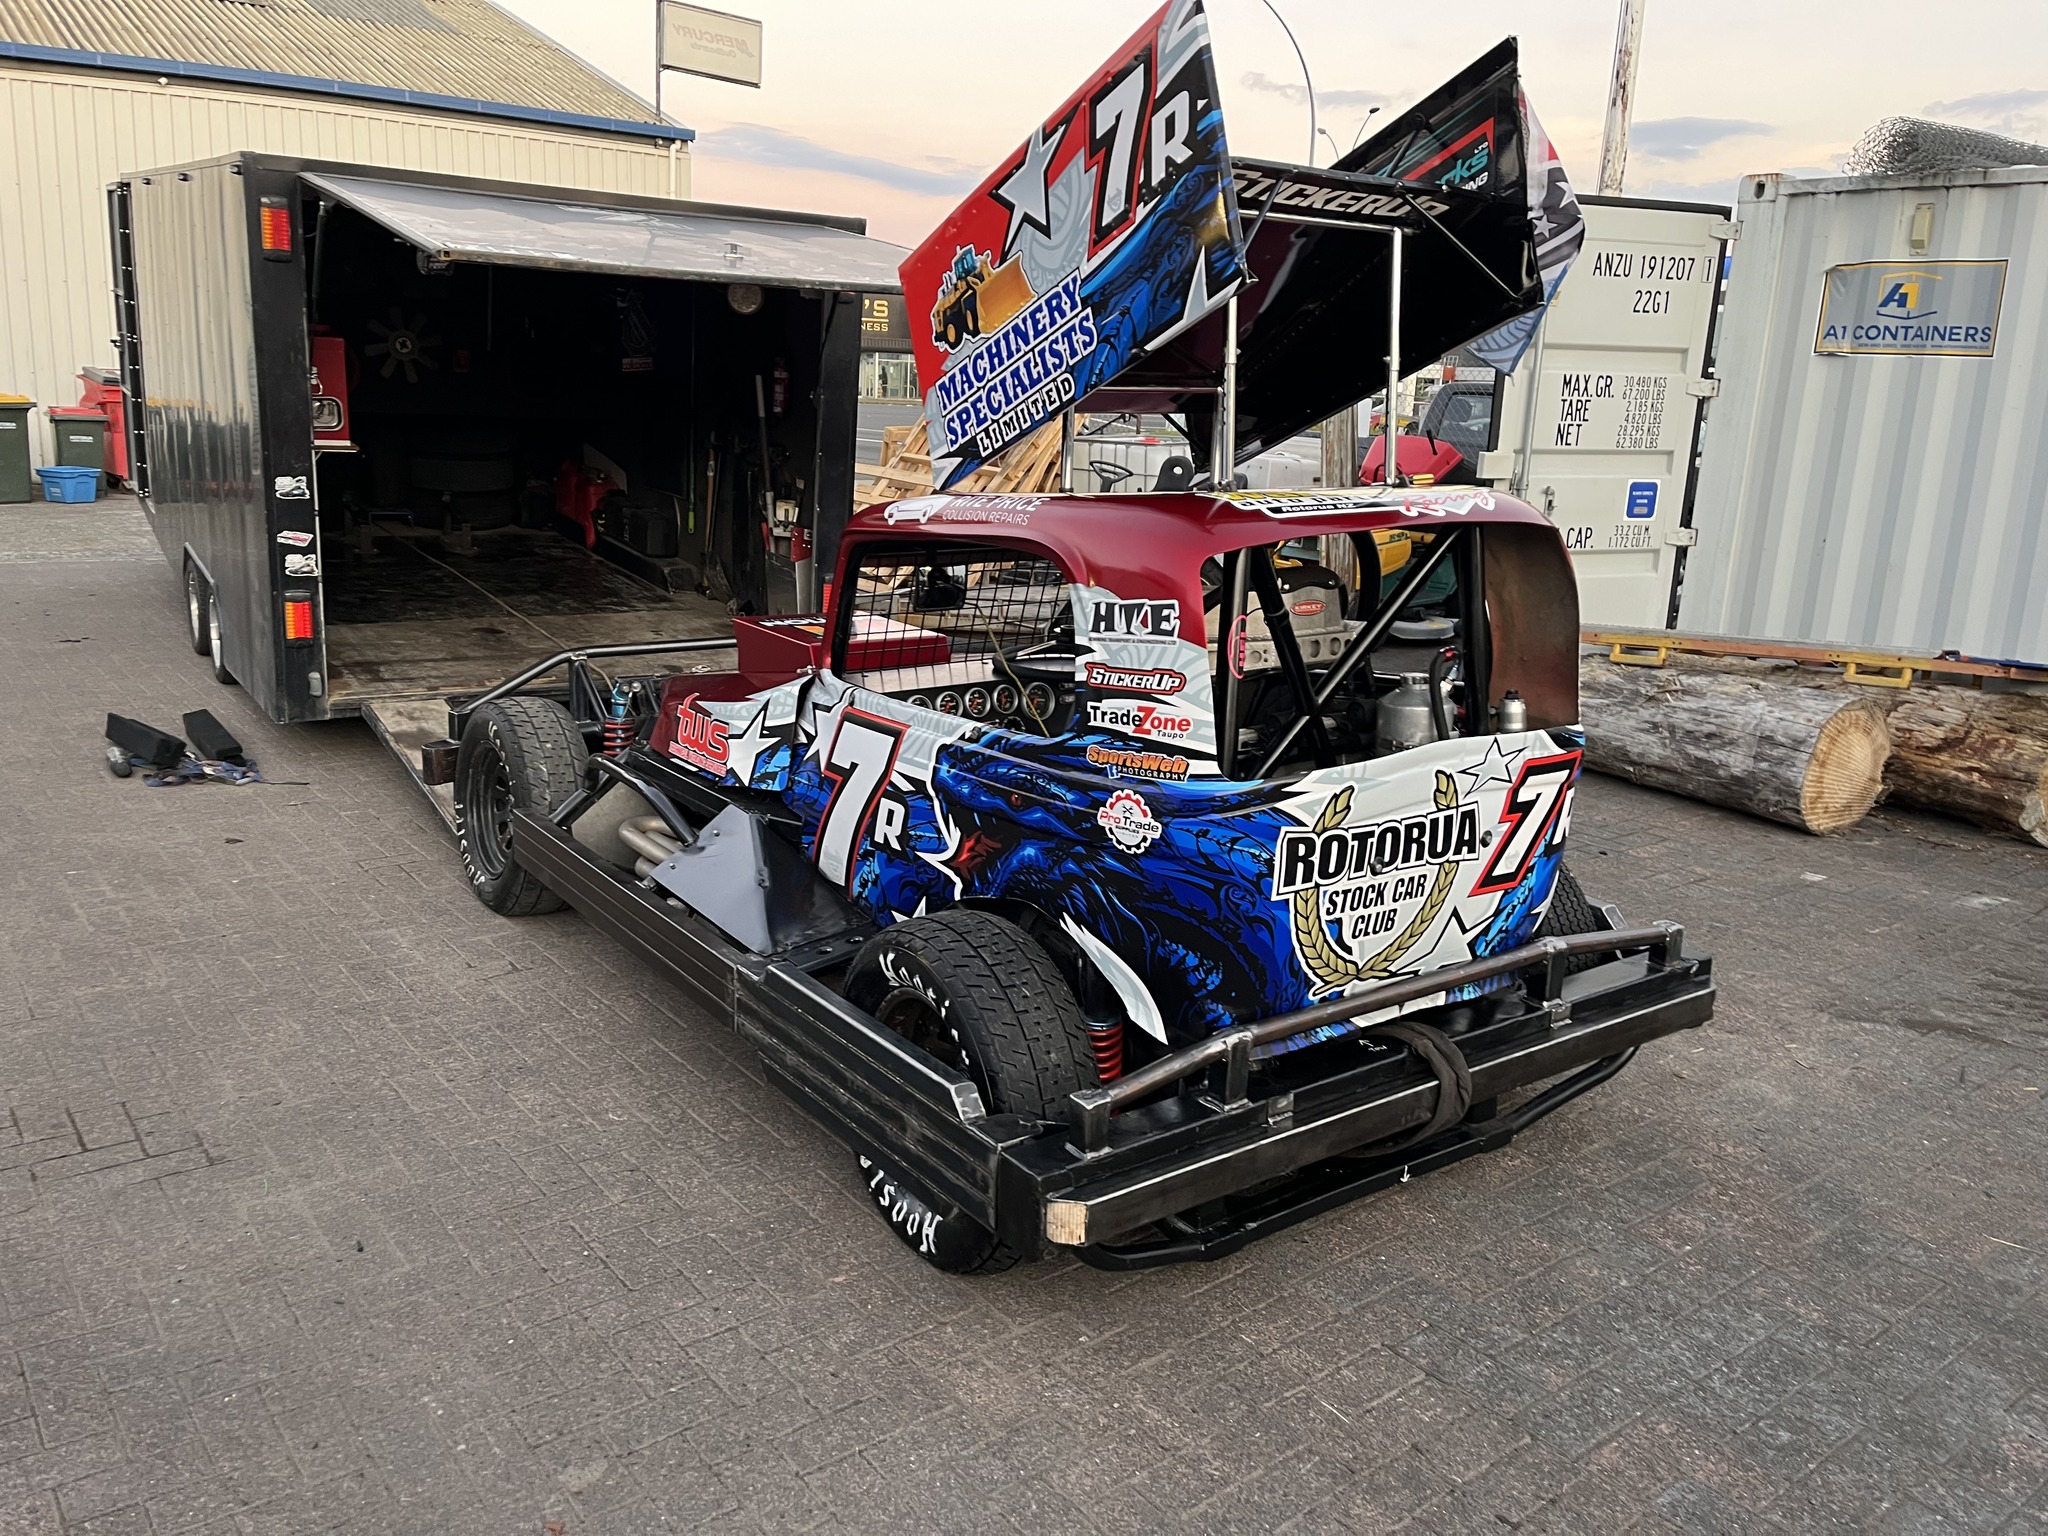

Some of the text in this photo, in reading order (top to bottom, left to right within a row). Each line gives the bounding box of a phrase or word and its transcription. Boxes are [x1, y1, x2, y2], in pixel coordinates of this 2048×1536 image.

[1434, 148, 1490, 185] cks
[1592, 251, 1634, 278] ANZU
[1640, 254, 1696, 282] 191207
[1632, 289, 1670, 314] 22G1
[937, 273, 1081, 412] MACHINERY
[1823, 325, 1992, 343] A1 CONTAINERS
[946, 311, 1096, 448] SPECIALISTS
[1623, 376, 1668, 389] 30.480 KGS
[1622, 389, 1666, 401] 67.200 LBS
[977, 377, 1075, 456] LIMITED
[1560, 399, 1592, 422] TARE
[1625, 401, 1664, 413] 2.185 KGS
[1624, 413, 1662, 425] 4.820 LBS
[1555, 423, 1583, 446] NET
[1617, 425, 1661, 437] 28.295 KGS
[1615, 437, 1659, 449] 62.380 LBS
[987, 497, 1050, 512] PRICE
[1281, 503, 1335, 513] Rotorua
[942, 509, 1031, 526] COLLISION REPAIRS
[1566, 527, 1594, 549] CAP.
[1090, 602, 1178, 637] HTE
[1089, 705, 1192, 736] TradeZone
[1157, 729, 1185, 740] Taupo
[1088, 745, 1189, 774] SportsWeb
[1118, 766, 1187, 780] PHOTOGRAPHY
[1282, 807, 1479, 889] ROTORUA
[1326, 874, 1428, 916] STOCK CAR
[1351, 908, 1398, 940] CLUB
